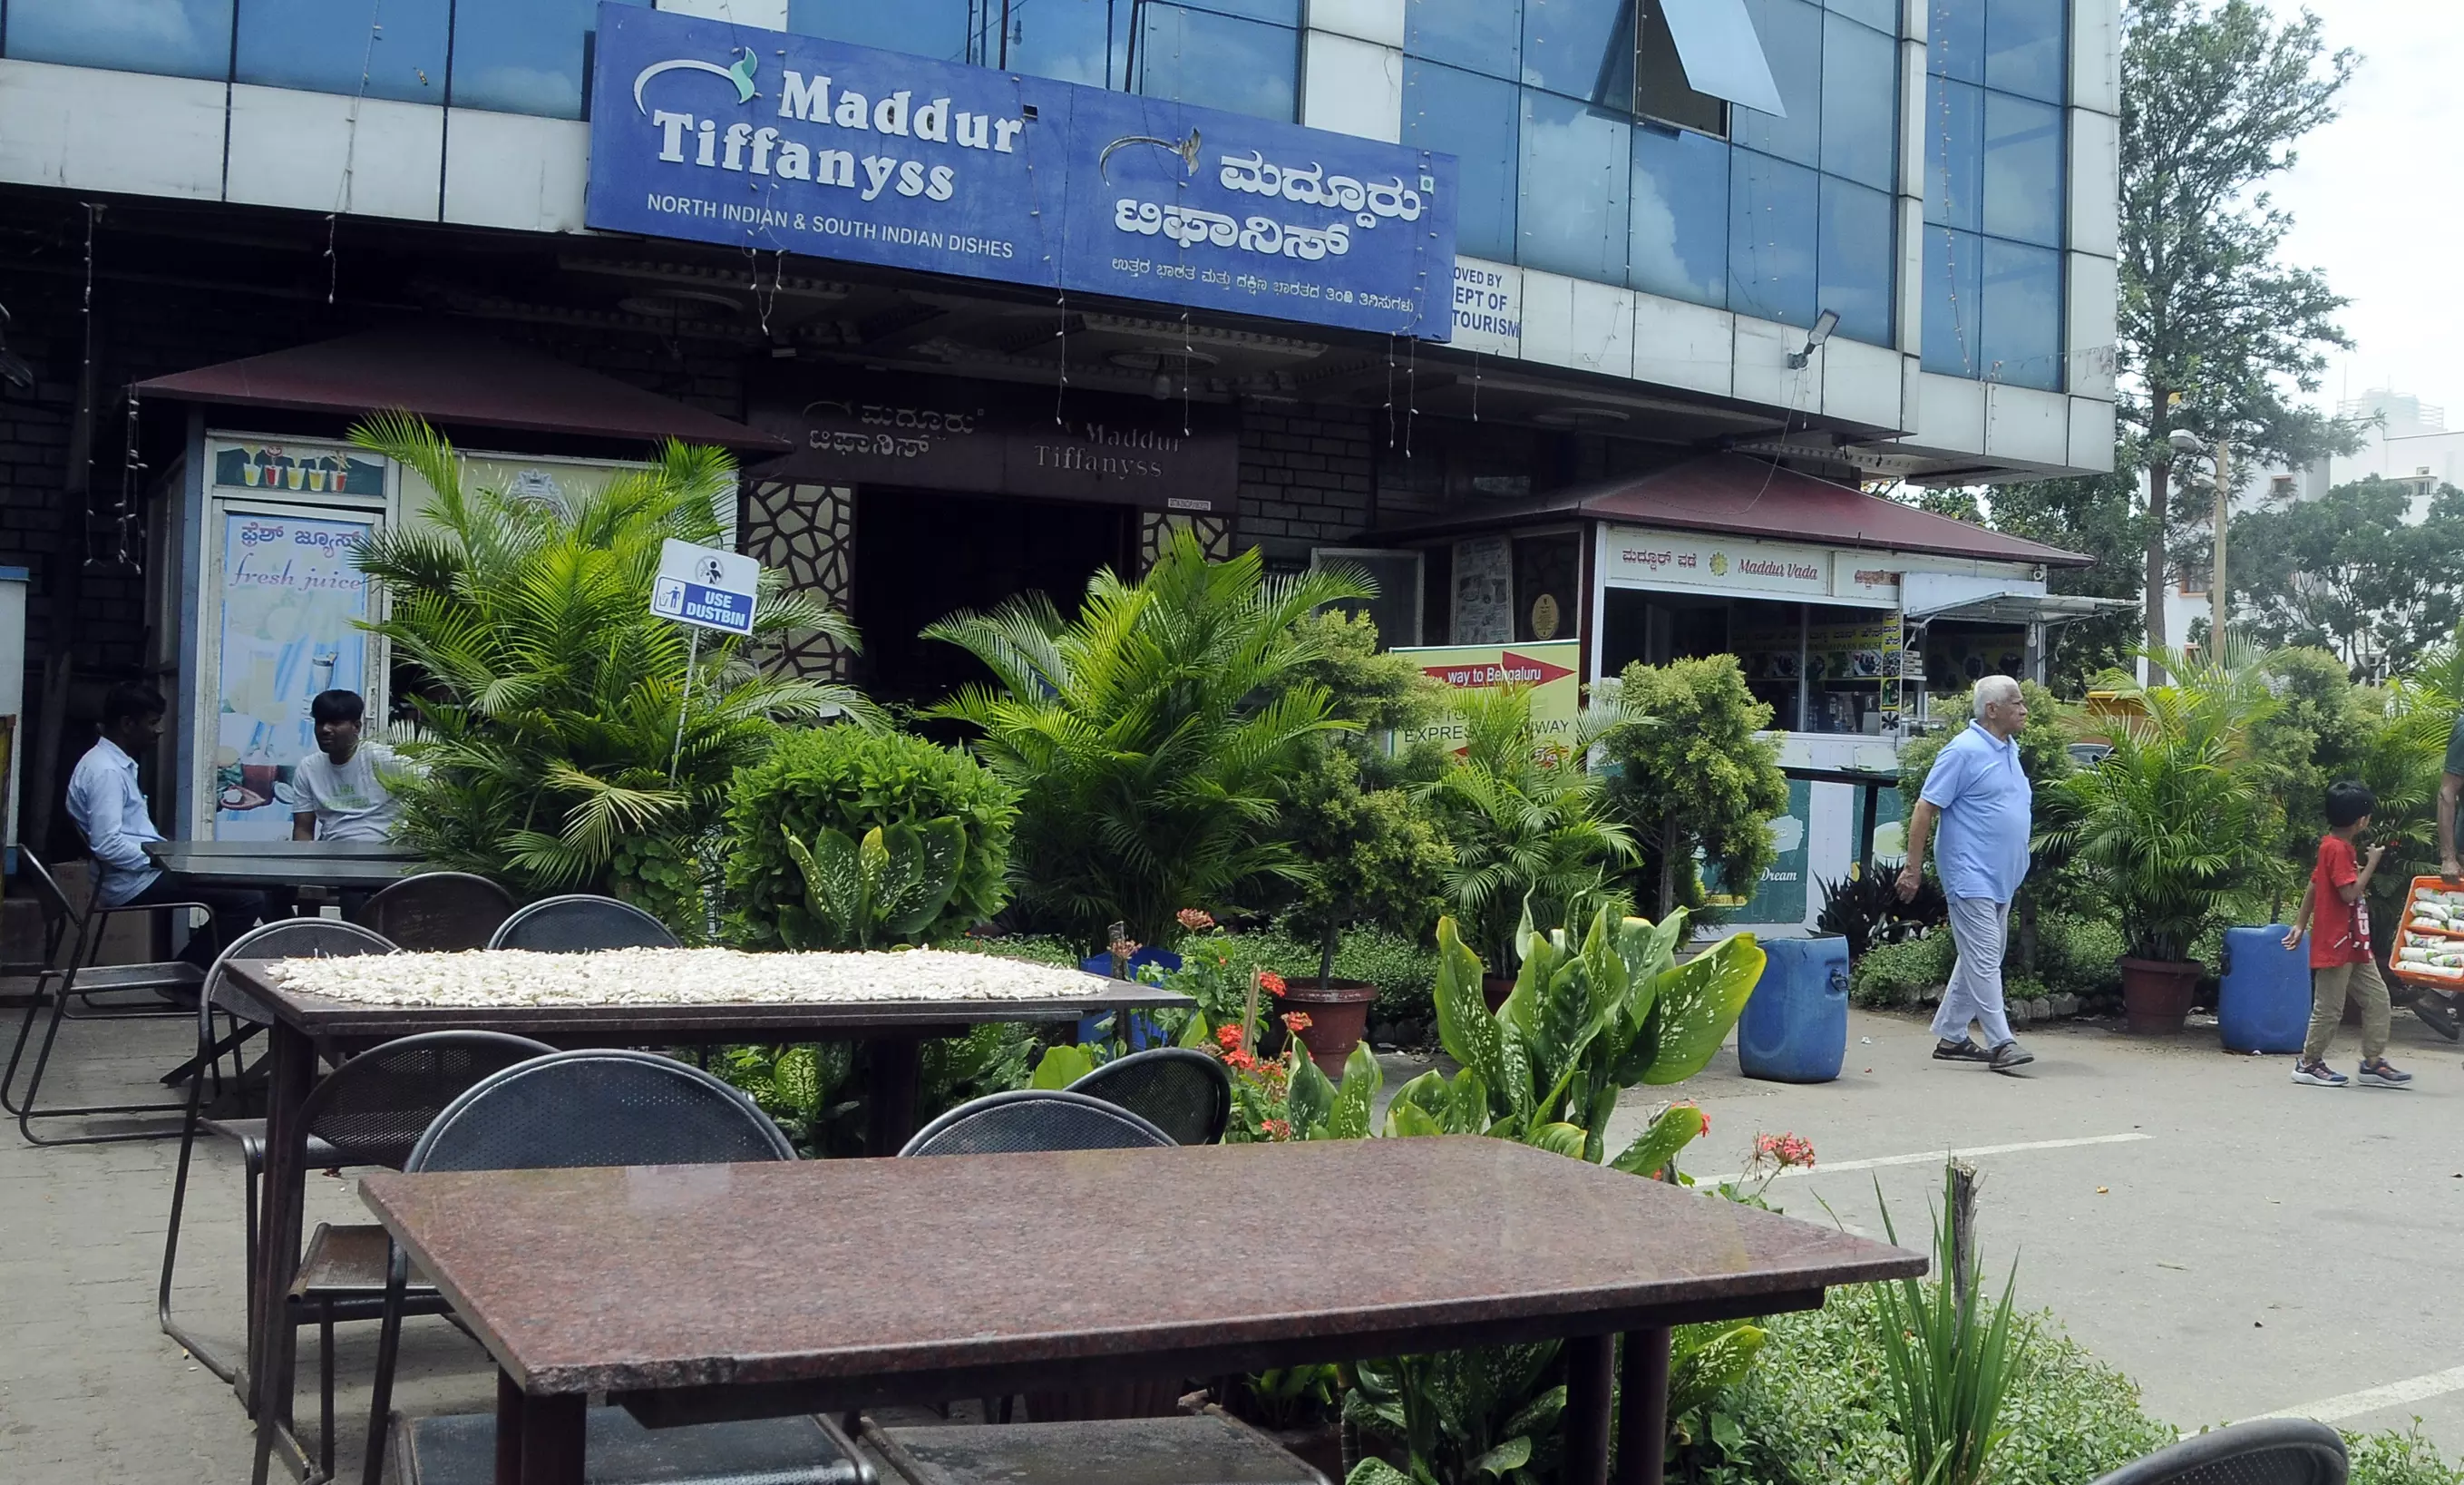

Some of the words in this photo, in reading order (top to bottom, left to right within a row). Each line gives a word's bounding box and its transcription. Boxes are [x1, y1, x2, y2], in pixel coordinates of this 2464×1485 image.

[778, 70, 1026, 153] Maddur
[653, 109, 955, 201] Tiffanyss
[1219, 151, 1423, 229] ಮದ್ದೂರು
[648, 193, 716, 219] NORTH
[723, 203, 788, 229] INDIAN
[794, 214, 806, 230] &
[813, 216, 876, 239] SOUTH
[881, 226, 943, 249] INDIAN
[949, 235, 1014, 259] DISHES
[1112, 256, 1151, 278] ಉತ್ತರ
[1156, 264, 1196, 280] ಭಾರತ
[1202, 269, 1231, 290] ಮತ್ತು
[1237, 273, 1268, 296] ದಕ್ಷಿಣ
[1272, 280, 1320, 298] ಭಾರತದ
[1453, 267, 1484, 285] OVED
[1487, 273, 1502, 288] BY
[1454, 286, 1484, 308] EPT
[1488, 293, 1507, 311] OF
[1452, 309, 1520, 338] TOURISM
[1085, 421, 1184, 454] Maddur
[1034, 445, 1164, 481] Tiffanyss
[229, 552, 295, 587] fresh
[298, 568, 364, 591] juice
[1738, 559, 1785, 578] Maddur
[1787, 563, 1818, 581] Vada
[686, 601, 745, 627] DUSTBIN
[705, 591, 733, 609] USE
[1447, 671, 1470, 686] way
[1473, 669, 1484, 683] to
[1405, 725, 1476, 742] EXPRES
[1760, 867, 1797, 883] Dream
